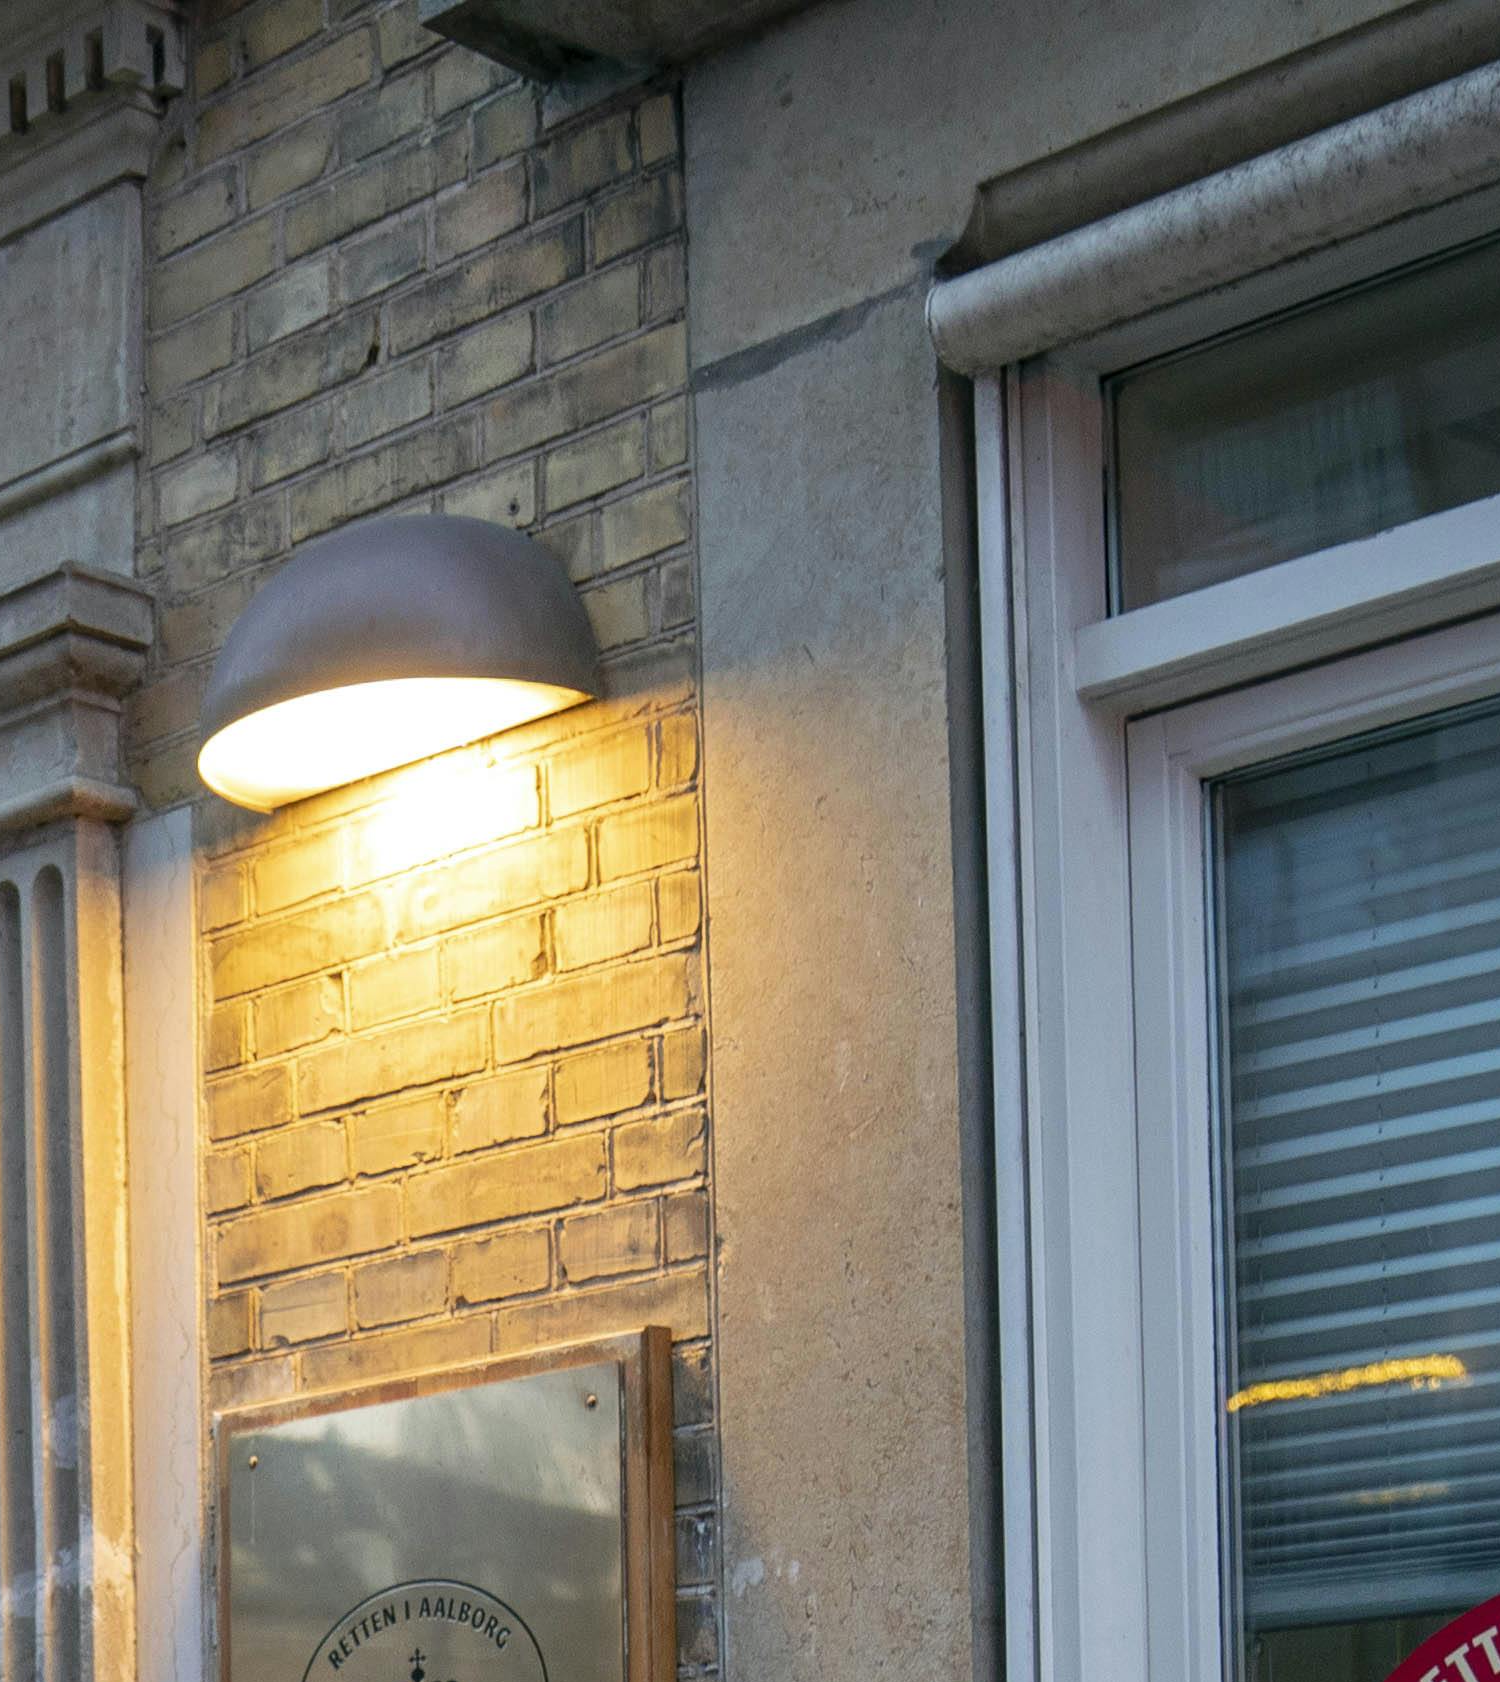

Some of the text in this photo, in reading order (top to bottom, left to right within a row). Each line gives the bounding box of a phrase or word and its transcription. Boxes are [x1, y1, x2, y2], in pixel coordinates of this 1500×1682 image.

[328, 1597, 511, 1670] RETTEN I AALBORG
